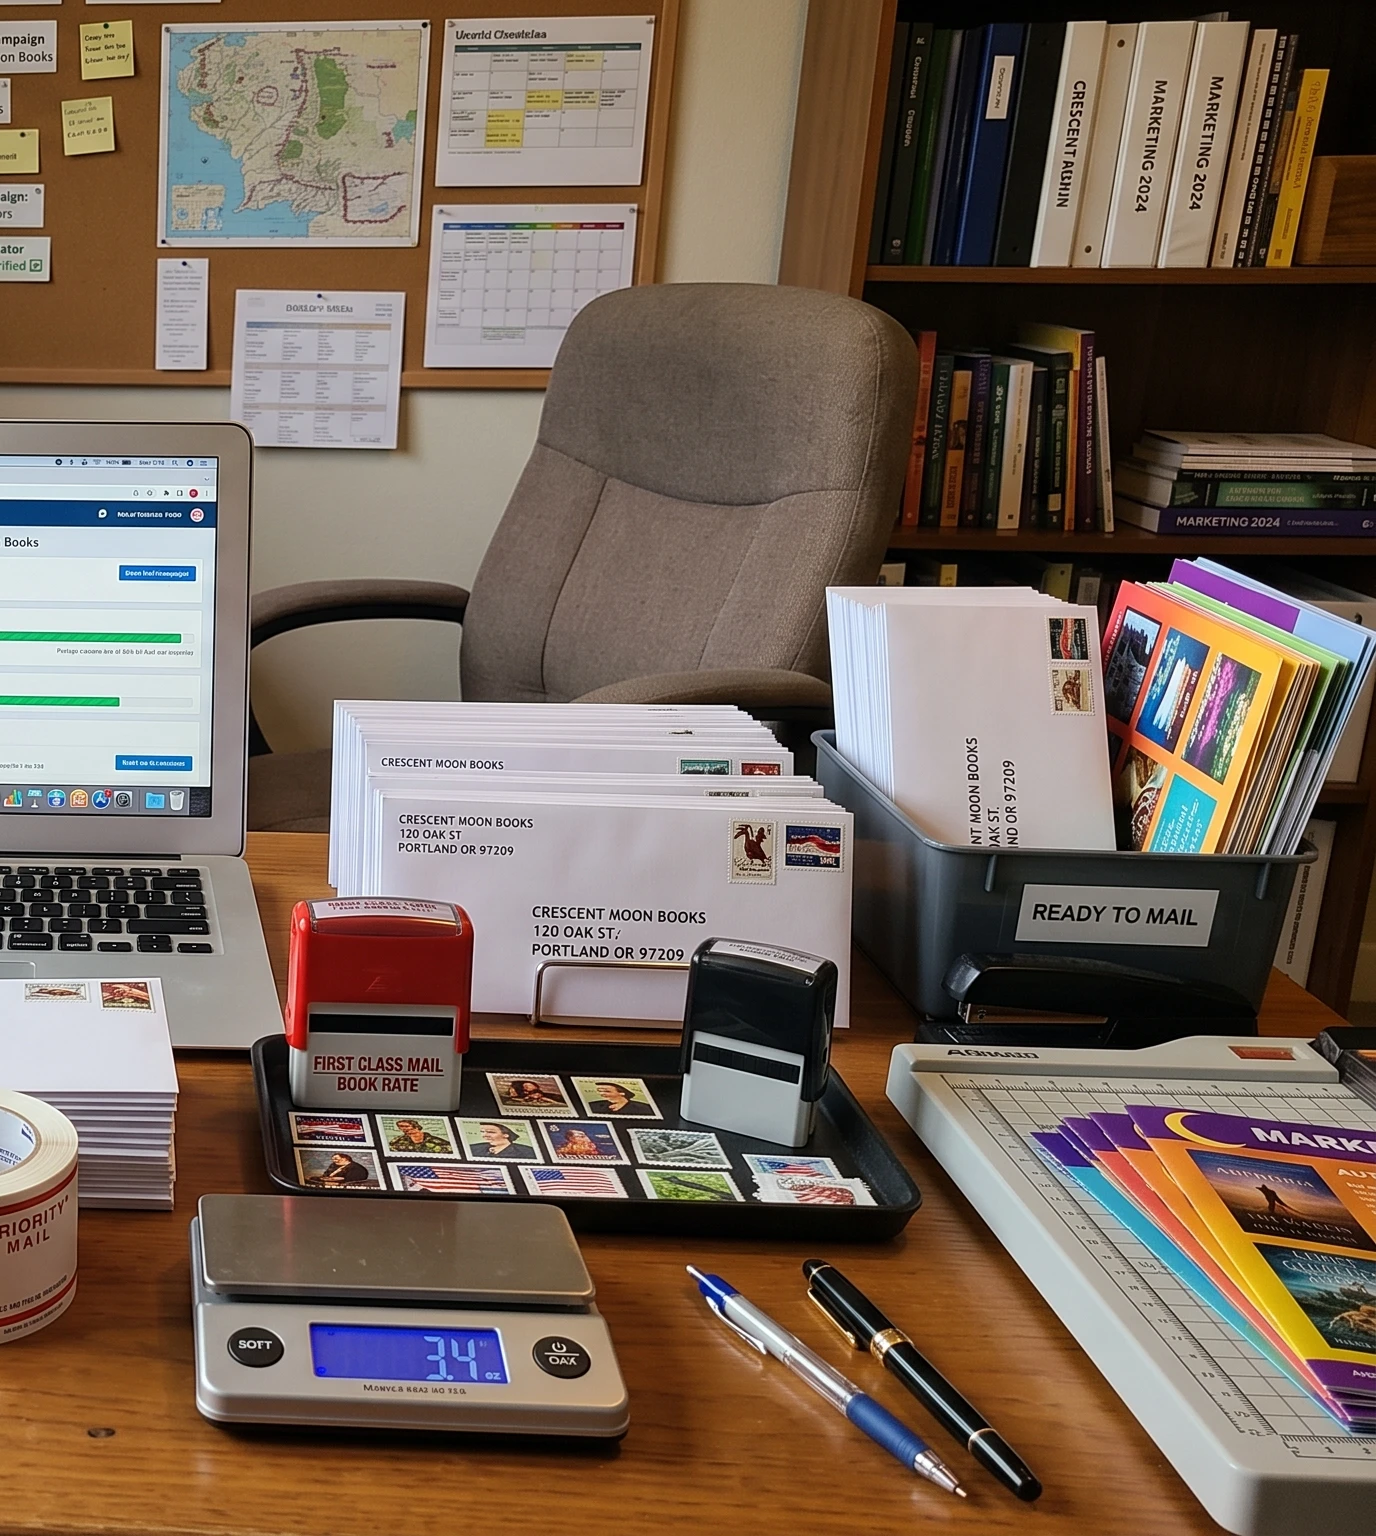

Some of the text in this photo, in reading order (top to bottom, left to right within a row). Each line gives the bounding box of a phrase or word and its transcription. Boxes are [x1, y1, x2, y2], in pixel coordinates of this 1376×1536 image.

[18, 51, 53, 62] Books
[1064, 81, 1086, 157] CRESCENT
[1135, 80, 1168, 213] MARKETING 2024
[1189, 76, 1224, 211] MARKETING 2024
[1176, 516, 1281, 528] MARKETING 2024
[5, 537, 39, 548] Books
[381, 757, 504, 770] CRESCENT MOON BOOKS
[966, 737, 982, 823] MOON BOOKS
[1002, 760, 1017, 823] OR 97209
[398, 814, 534, 829] CRESCENT MOON BOOKS
[399, 829, 462, 840] 120 OAK ST
[398, 842, 514, 856] PORTLAND OR 97209
[532, 906, 707, 924] CRESCENT MOON BOOKS
[1032, 904, 1198, 926] READY TO MAIL
[534, 925, 593, 938] 120 OAK
[532, 944, 685, 961] PORTLAND OR 97209
[313, 1056, 444, 1073] FIRST CLASS MAIL
[337, 1076, 419, 1092] BOOK RATE
[7, 1229, 51, 1254] MAIL
